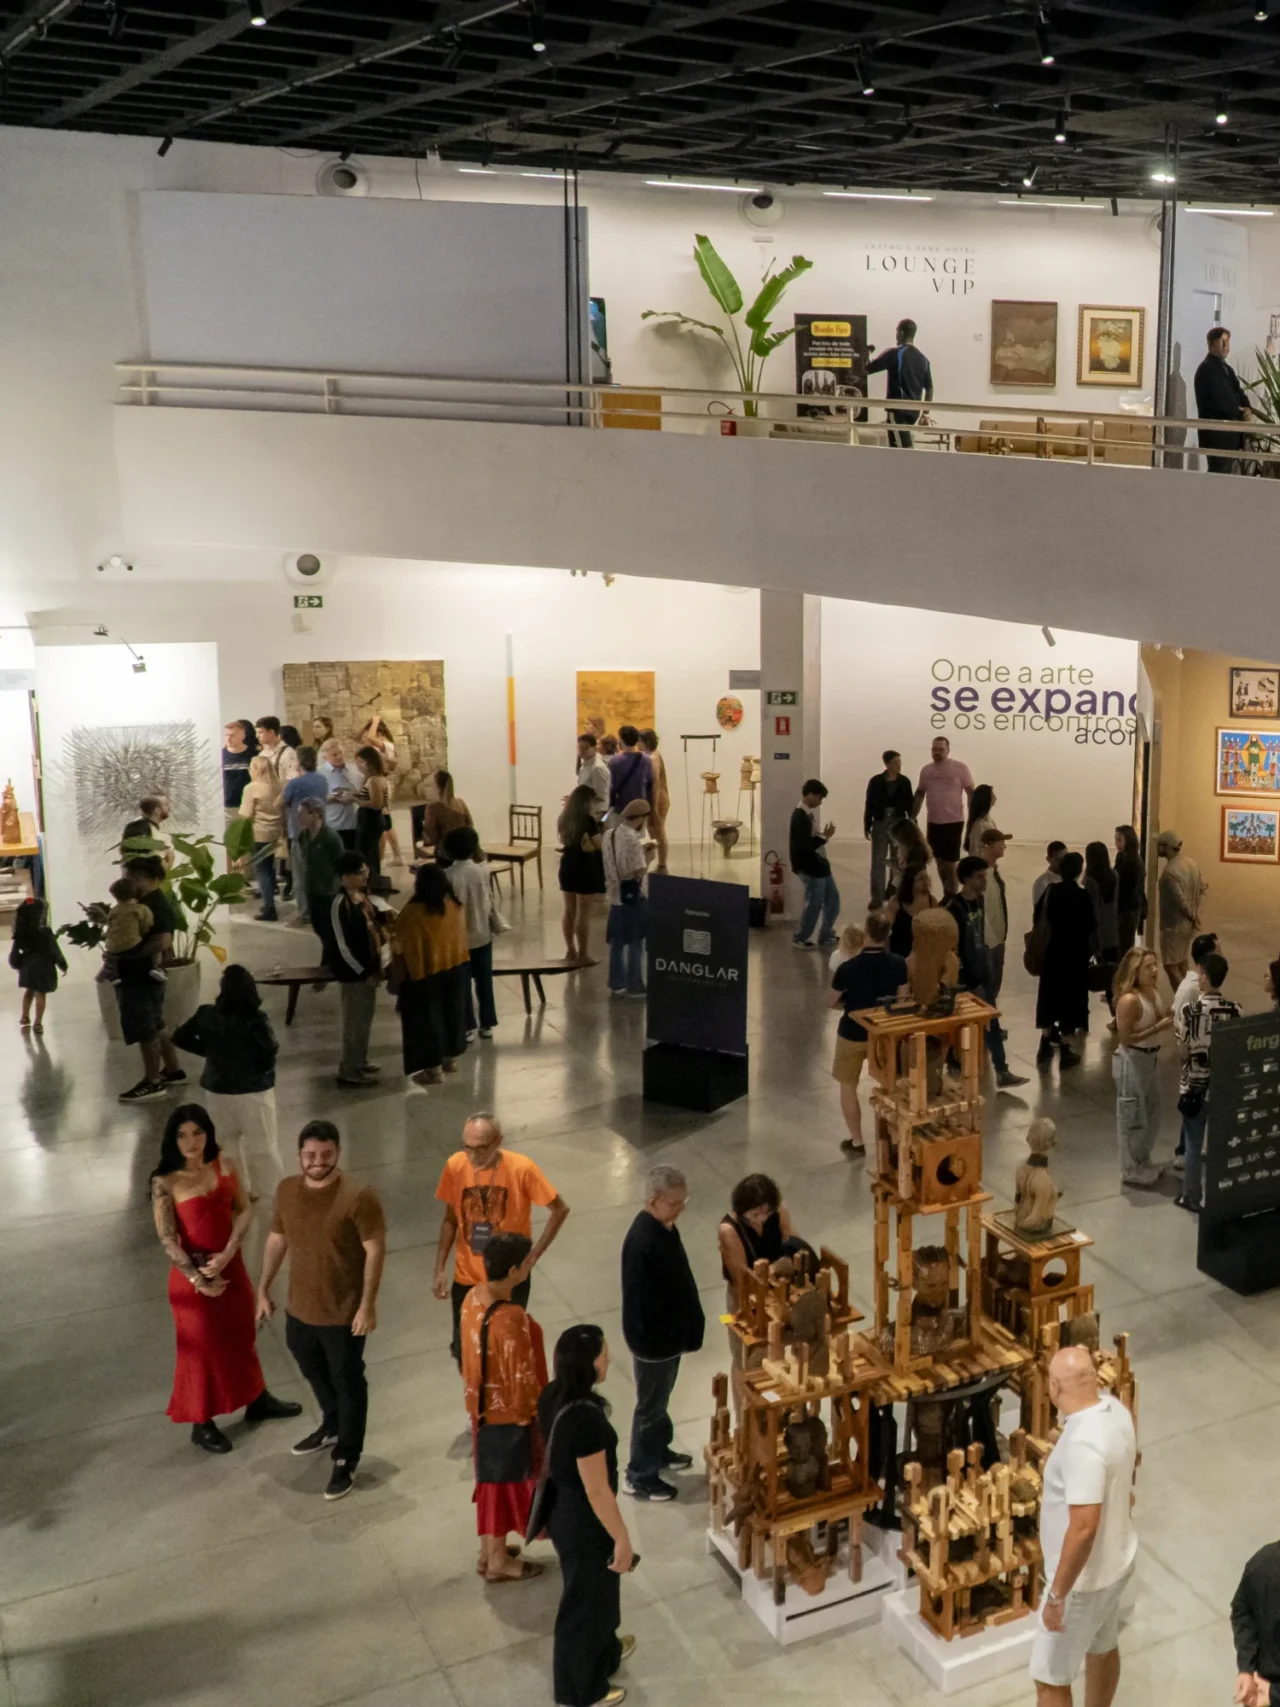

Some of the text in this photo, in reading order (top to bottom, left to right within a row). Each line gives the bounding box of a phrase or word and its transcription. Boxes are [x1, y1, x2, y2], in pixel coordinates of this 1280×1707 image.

[865, 255, 975, 274] LOUNGE
[932, 278, 975, 295] VIP
[931, 659, 1094, 685] Onde a arte
[930, 686, 979, 712] se
[930, 712, 1137, 734] e os encontros
[655, 958, 739, 981] DANGLAR
